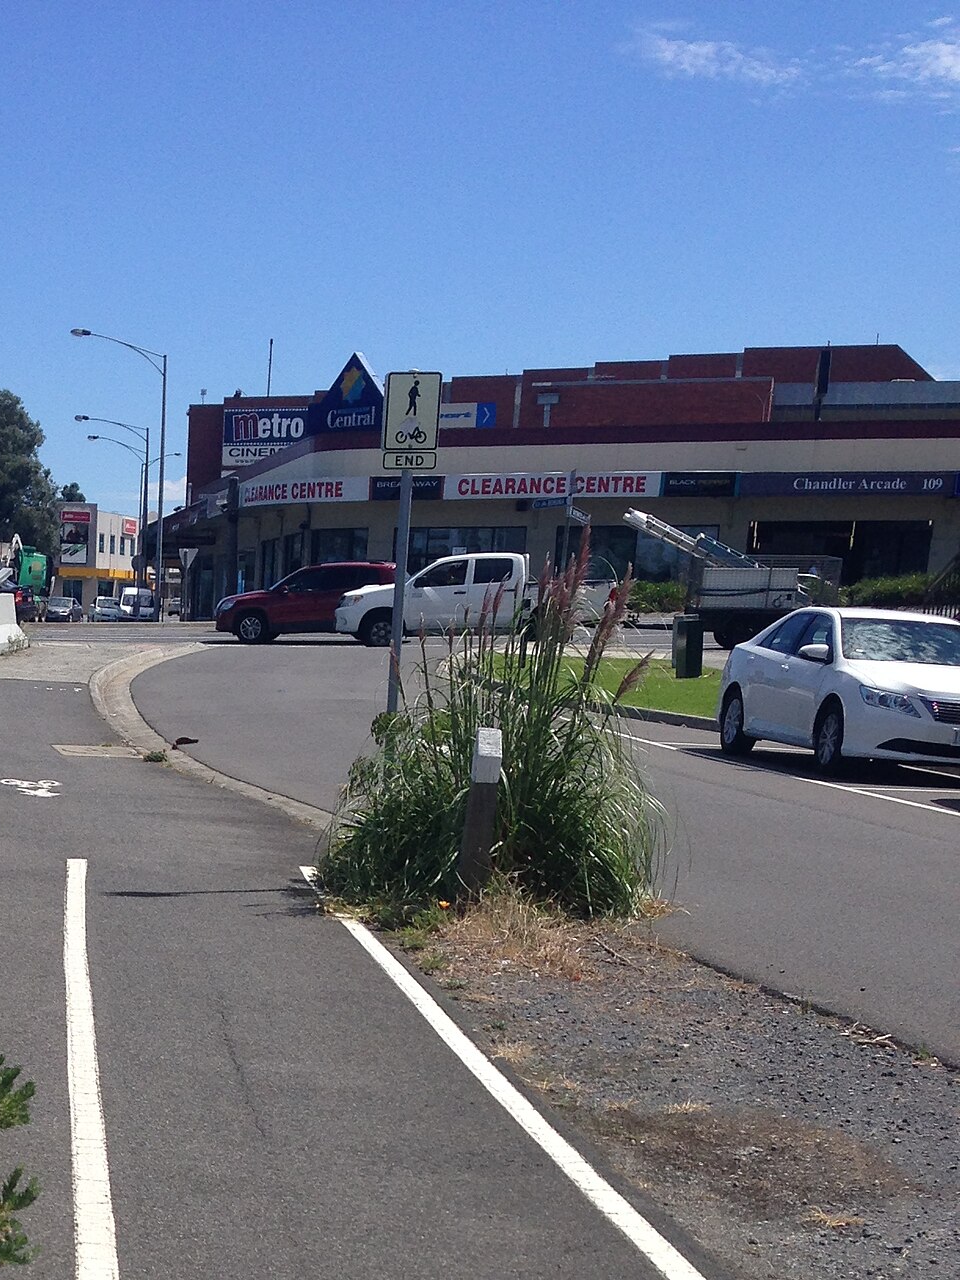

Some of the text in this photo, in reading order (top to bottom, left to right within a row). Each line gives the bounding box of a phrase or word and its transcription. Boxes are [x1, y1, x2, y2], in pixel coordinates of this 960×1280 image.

[233, 413, 304, 441] metro
[327, 406, 376, 428] Central
[229, 448, 285, 457] CINEM
[395, 455, 425, 466] END
[244, 481, 343, 503] CLEARANCE CENTRE
[457, 475, 647, 495] CLEARANCE CENTRE
[793, 478, 943, 490] Chandler Arcade 109
